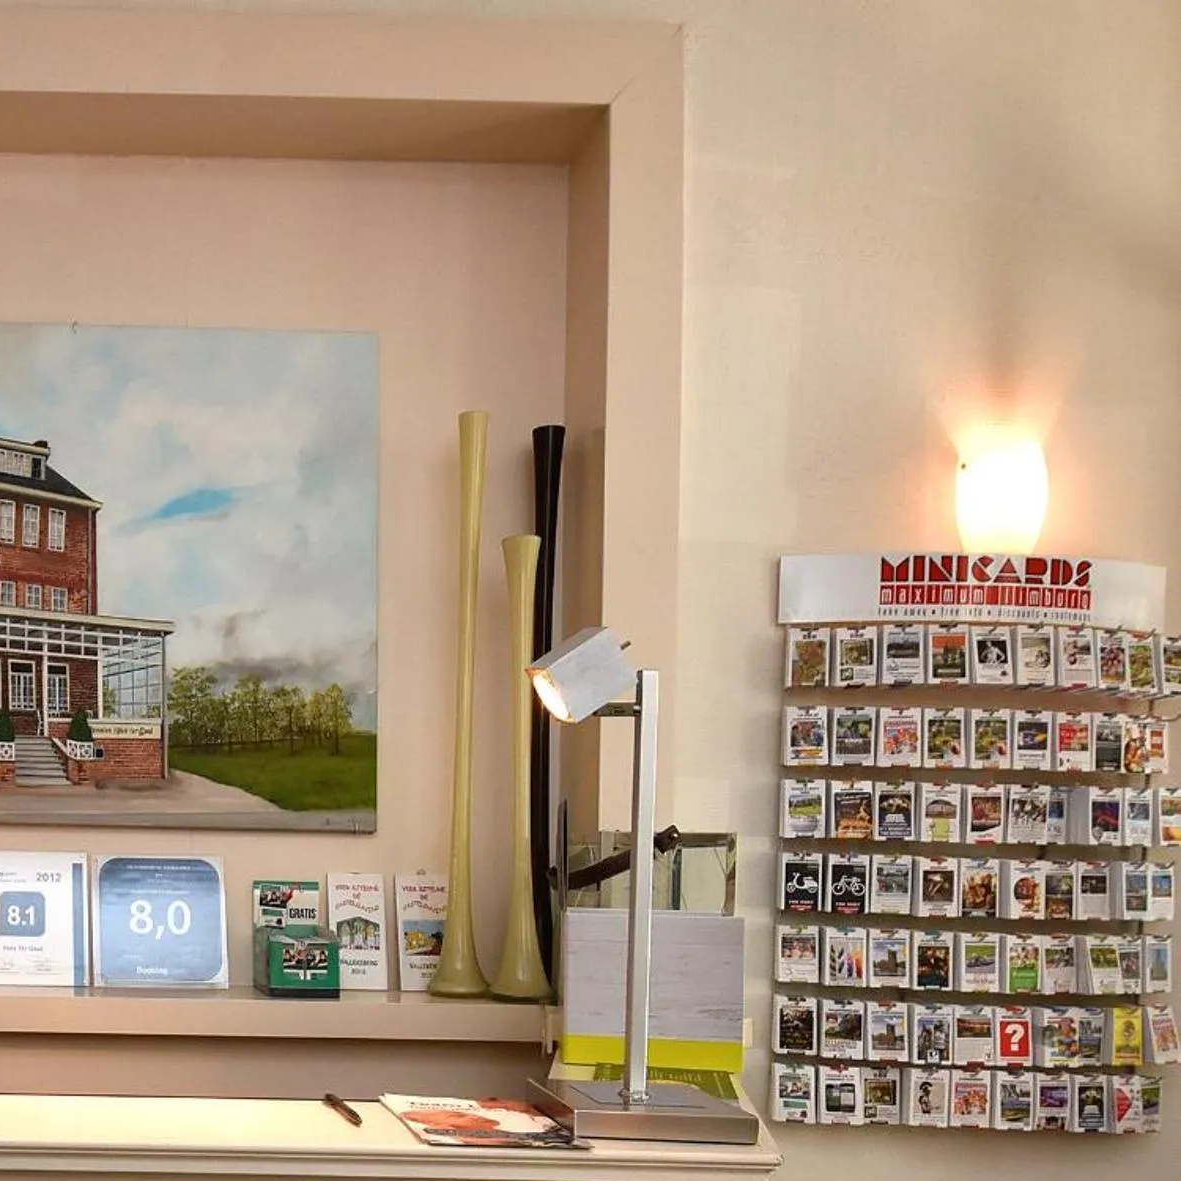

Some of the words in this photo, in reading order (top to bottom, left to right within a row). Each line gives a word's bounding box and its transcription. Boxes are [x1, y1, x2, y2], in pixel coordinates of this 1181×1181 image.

[881, 555, 1093, 587] MINICARDS
[881, 587, 984, 604] maximum
[1005, 587, 1091, 608] limburg
[35, 872, 62, 882] 2012
[7, 905, 36, 926] 8.1
[129, 900, 192, 940] 8,0
[289, 908, 317, 919] GRATIS
